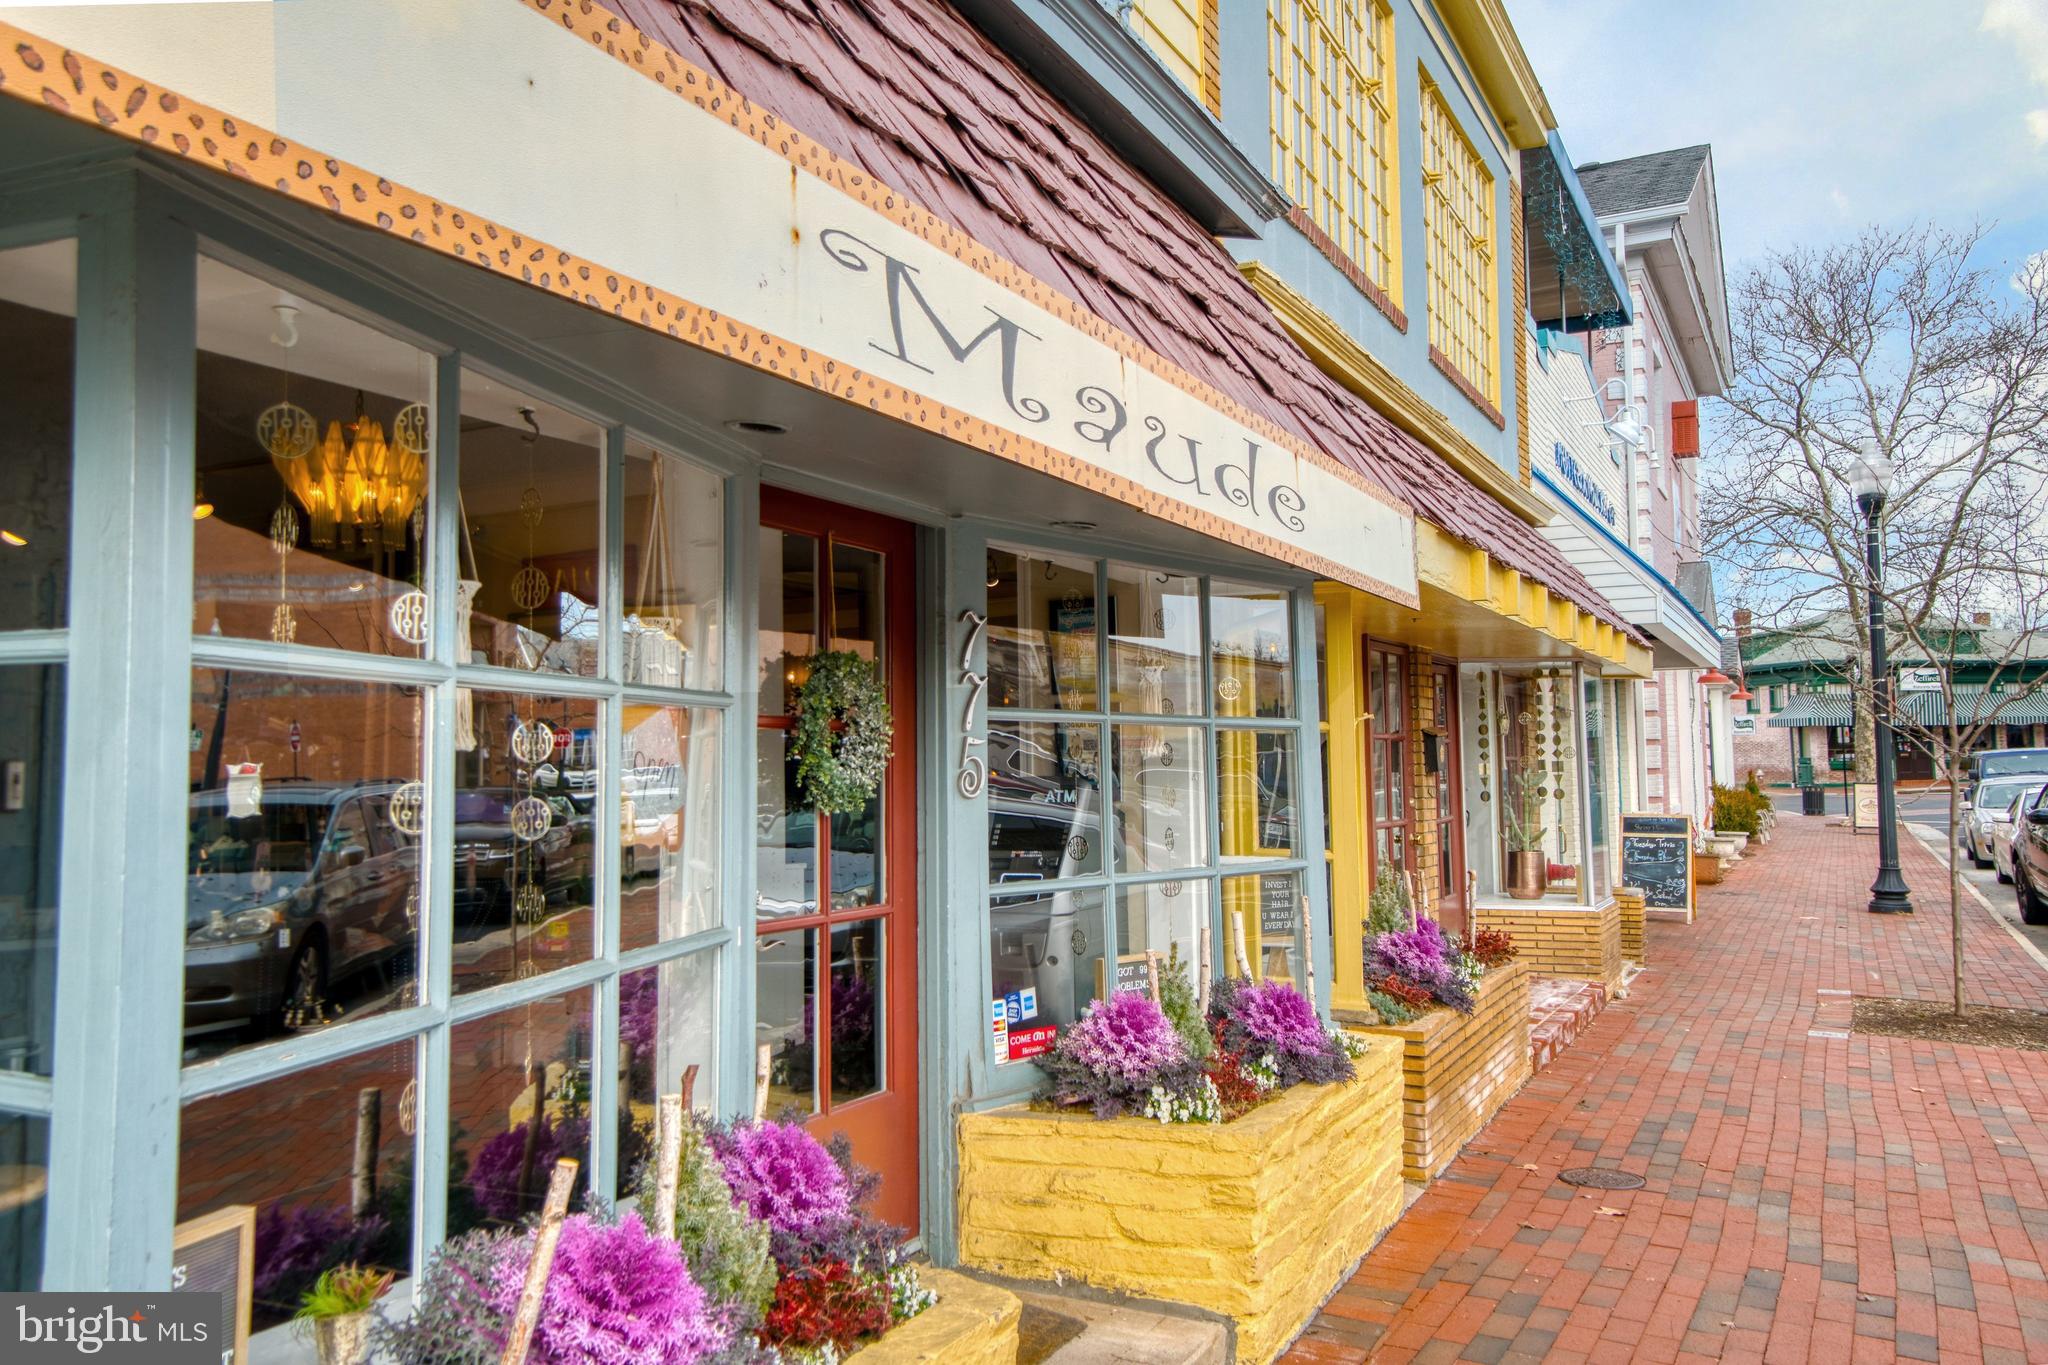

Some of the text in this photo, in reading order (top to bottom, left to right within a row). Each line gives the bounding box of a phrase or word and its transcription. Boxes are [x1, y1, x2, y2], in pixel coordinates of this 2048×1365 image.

[820, 228, 1305, 532] Maude
[958, 609, 989, 799] 775
[633, 751, 676, 801] Open
[1045, 789, 1075, 803] ATM
[1265, 881, 1287, 889] INVEST
[1272, 890, 1290, 898] YOUR
[1271, 900, 1289, 908] HAIR
[1270, 911, 1289, 919] WEAR
[1117, 964, 1148, 977] GOT 99
[1010, 1033, 1031, 1045] COME
